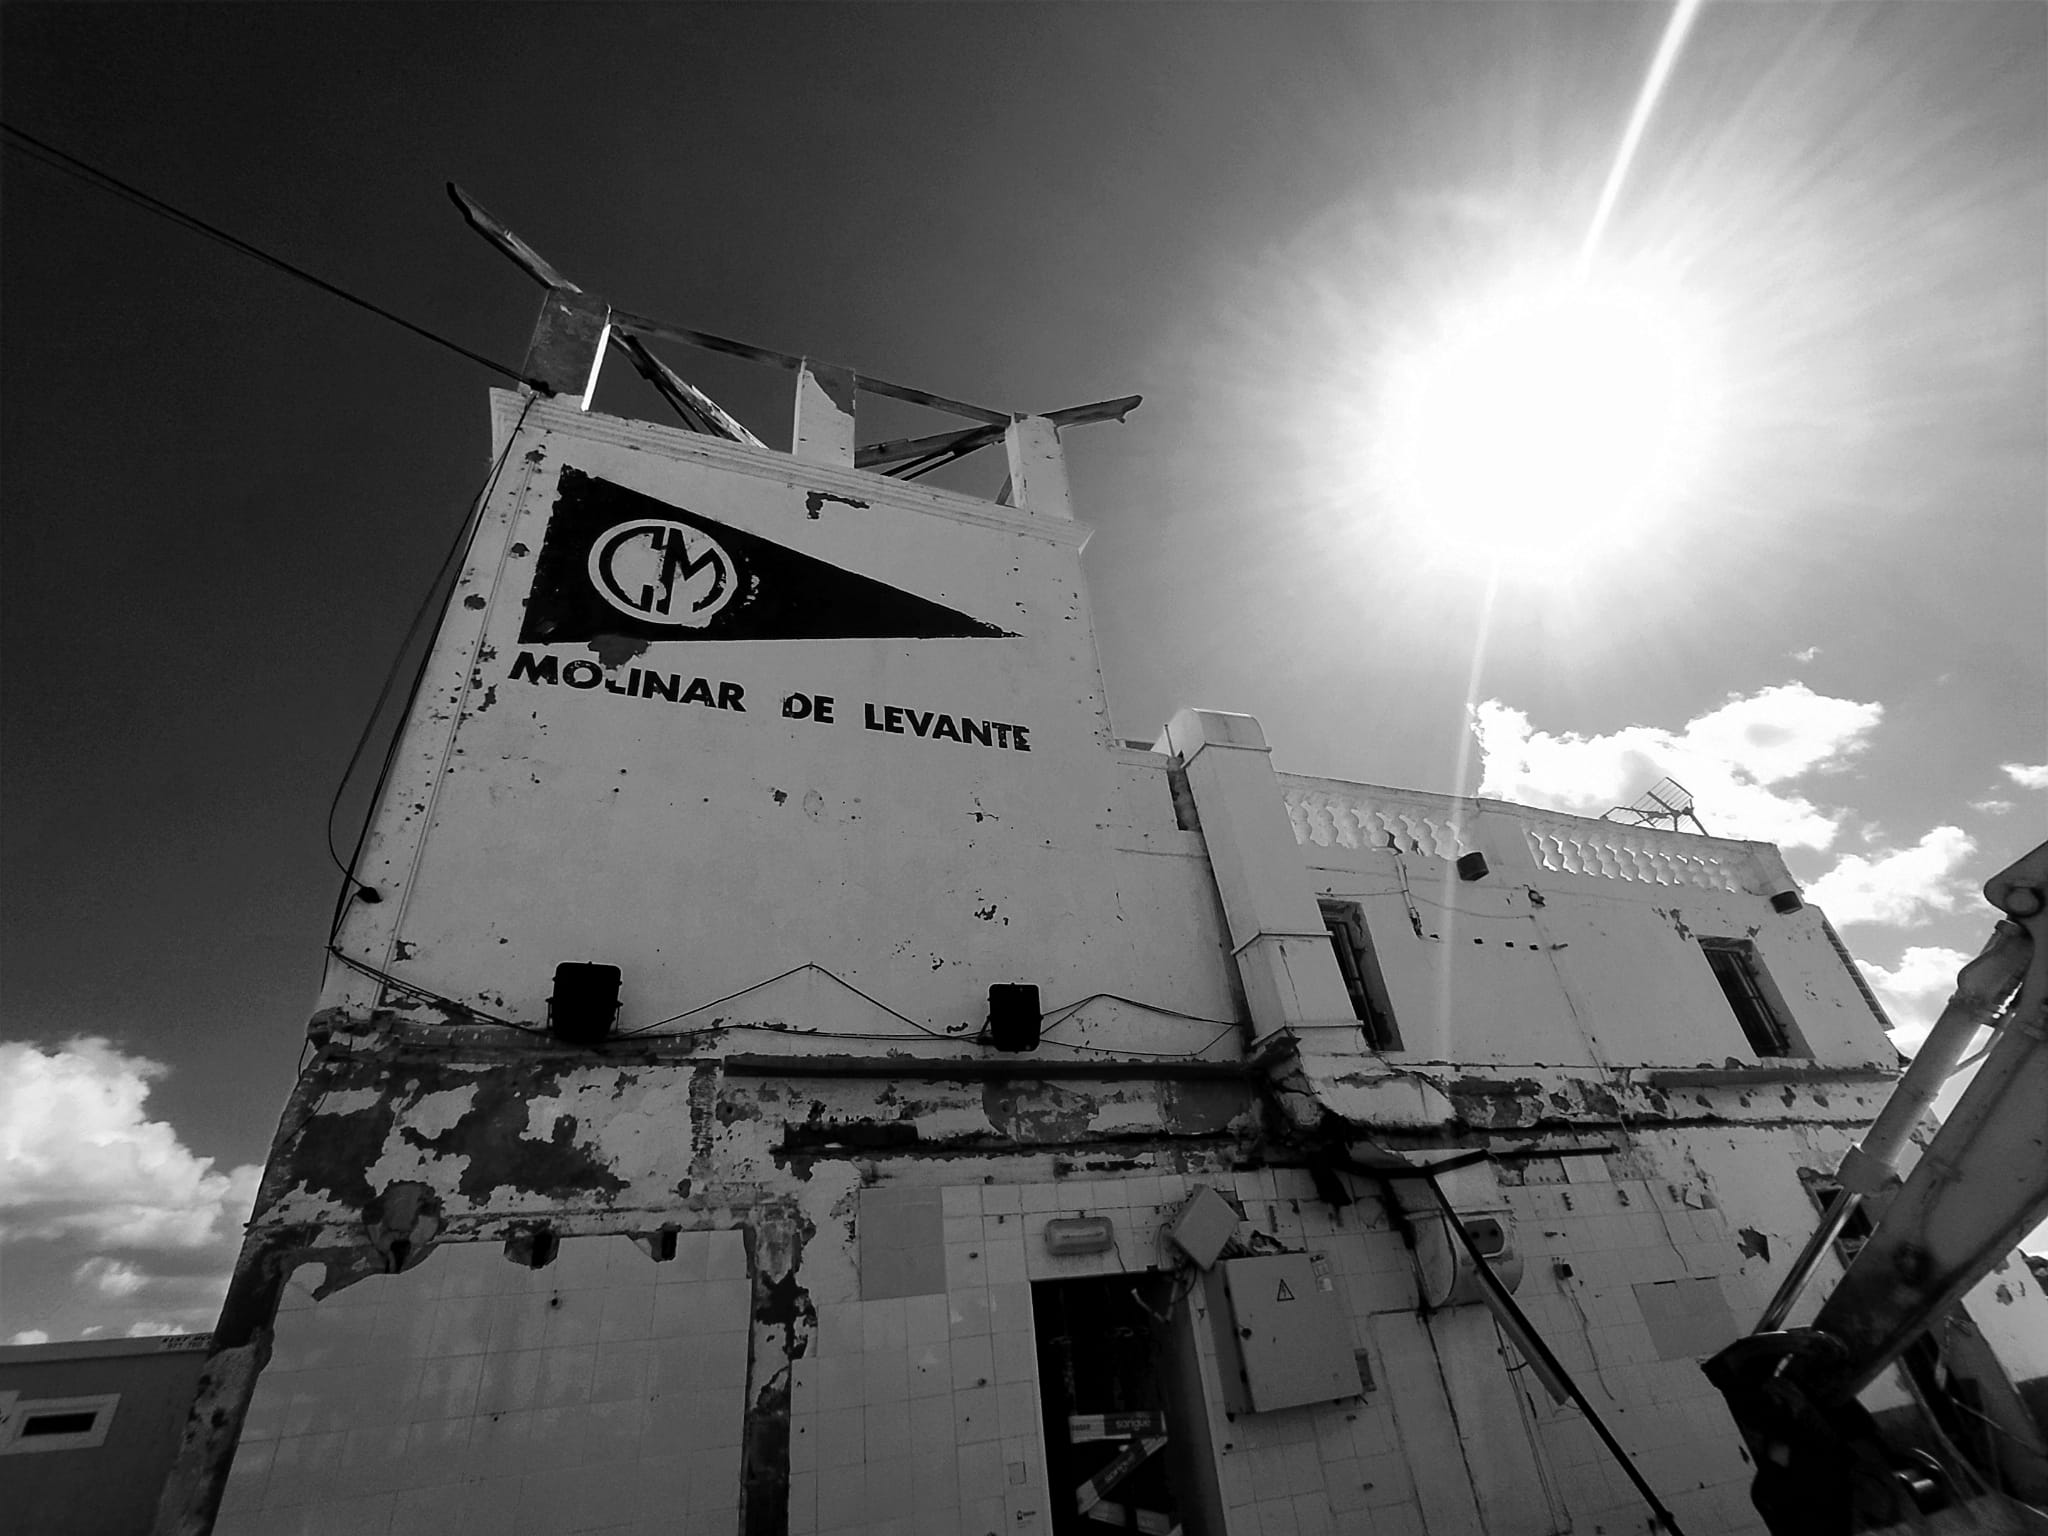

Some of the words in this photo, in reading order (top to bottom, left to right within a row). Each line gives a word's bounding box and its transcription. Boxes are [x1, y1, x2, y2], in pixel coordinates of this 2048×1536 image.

[507, 651, 747, 713] MOLINAR
[782, 692, 834, 724] DE
[864, 702, 1032, 752] LEVANTE
